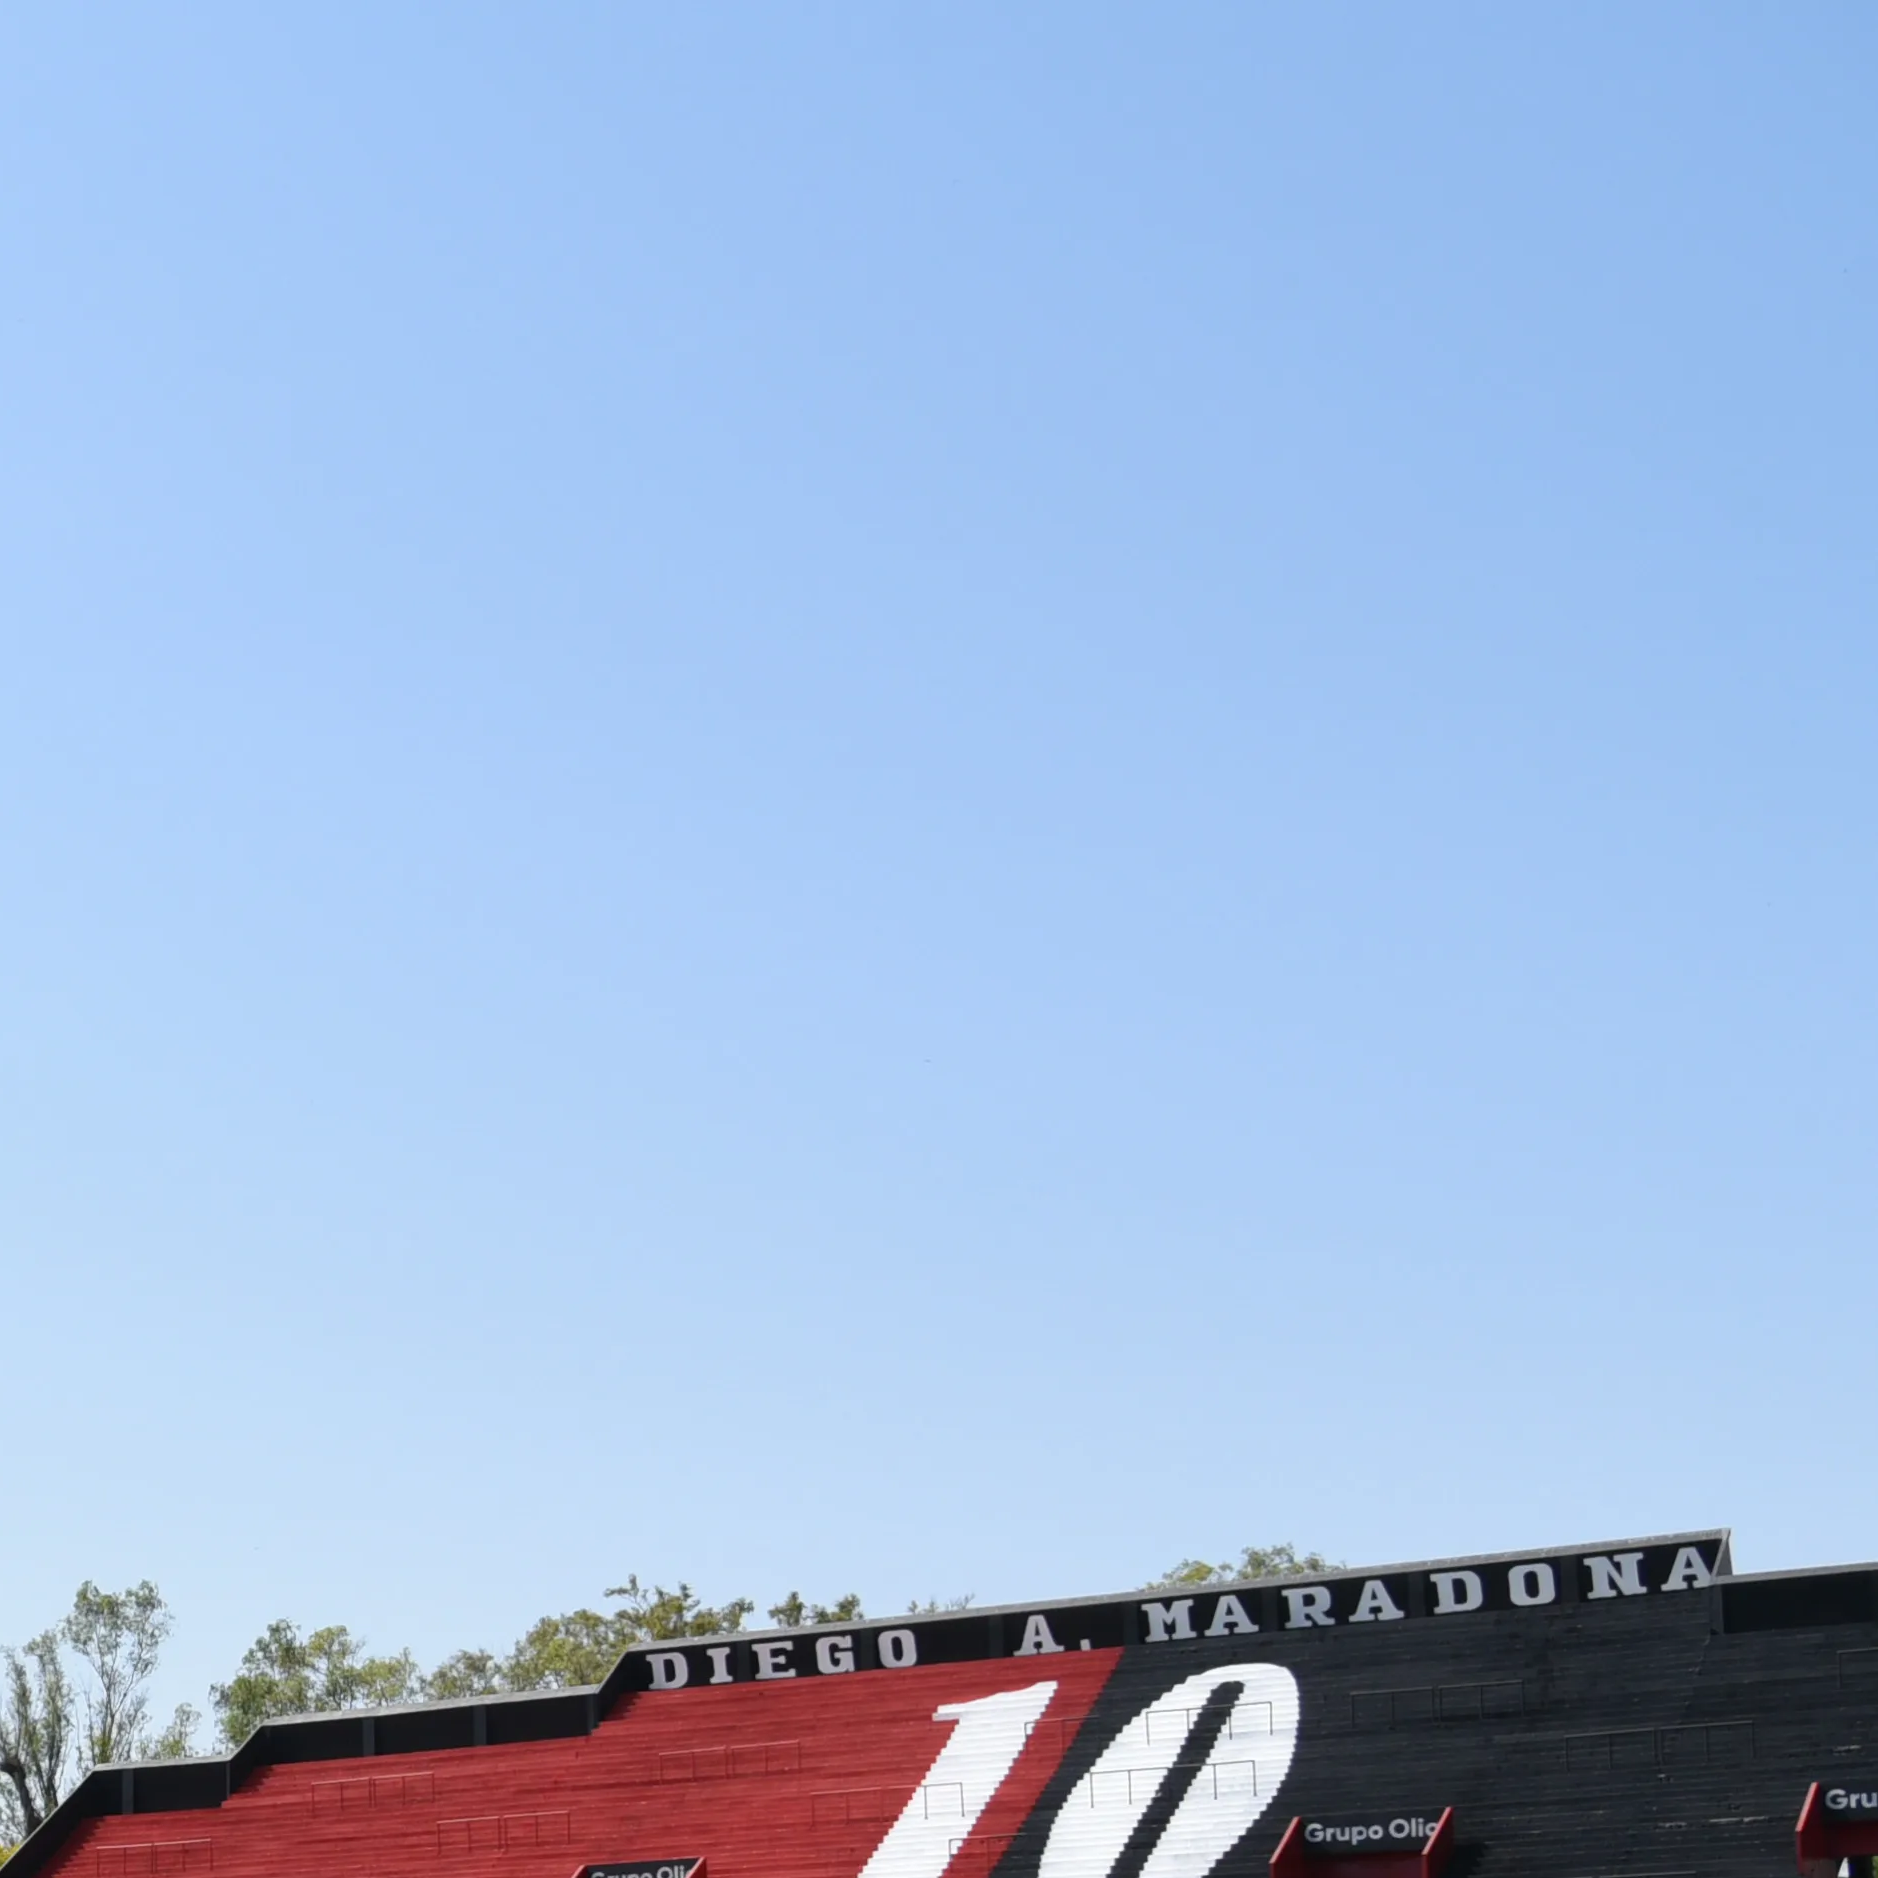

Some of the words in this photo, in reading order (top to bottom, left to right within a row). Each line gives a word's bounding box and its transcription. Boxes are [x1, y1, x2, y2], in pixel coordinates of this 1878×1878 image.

[645, 1628, 918, 1690] DIEGO
[1013, 1615, 1092, 1657] A.
[1142, 1546, 1715, 1643] MARADONA
[1304, 1823, 1384, 1846] Grupo
